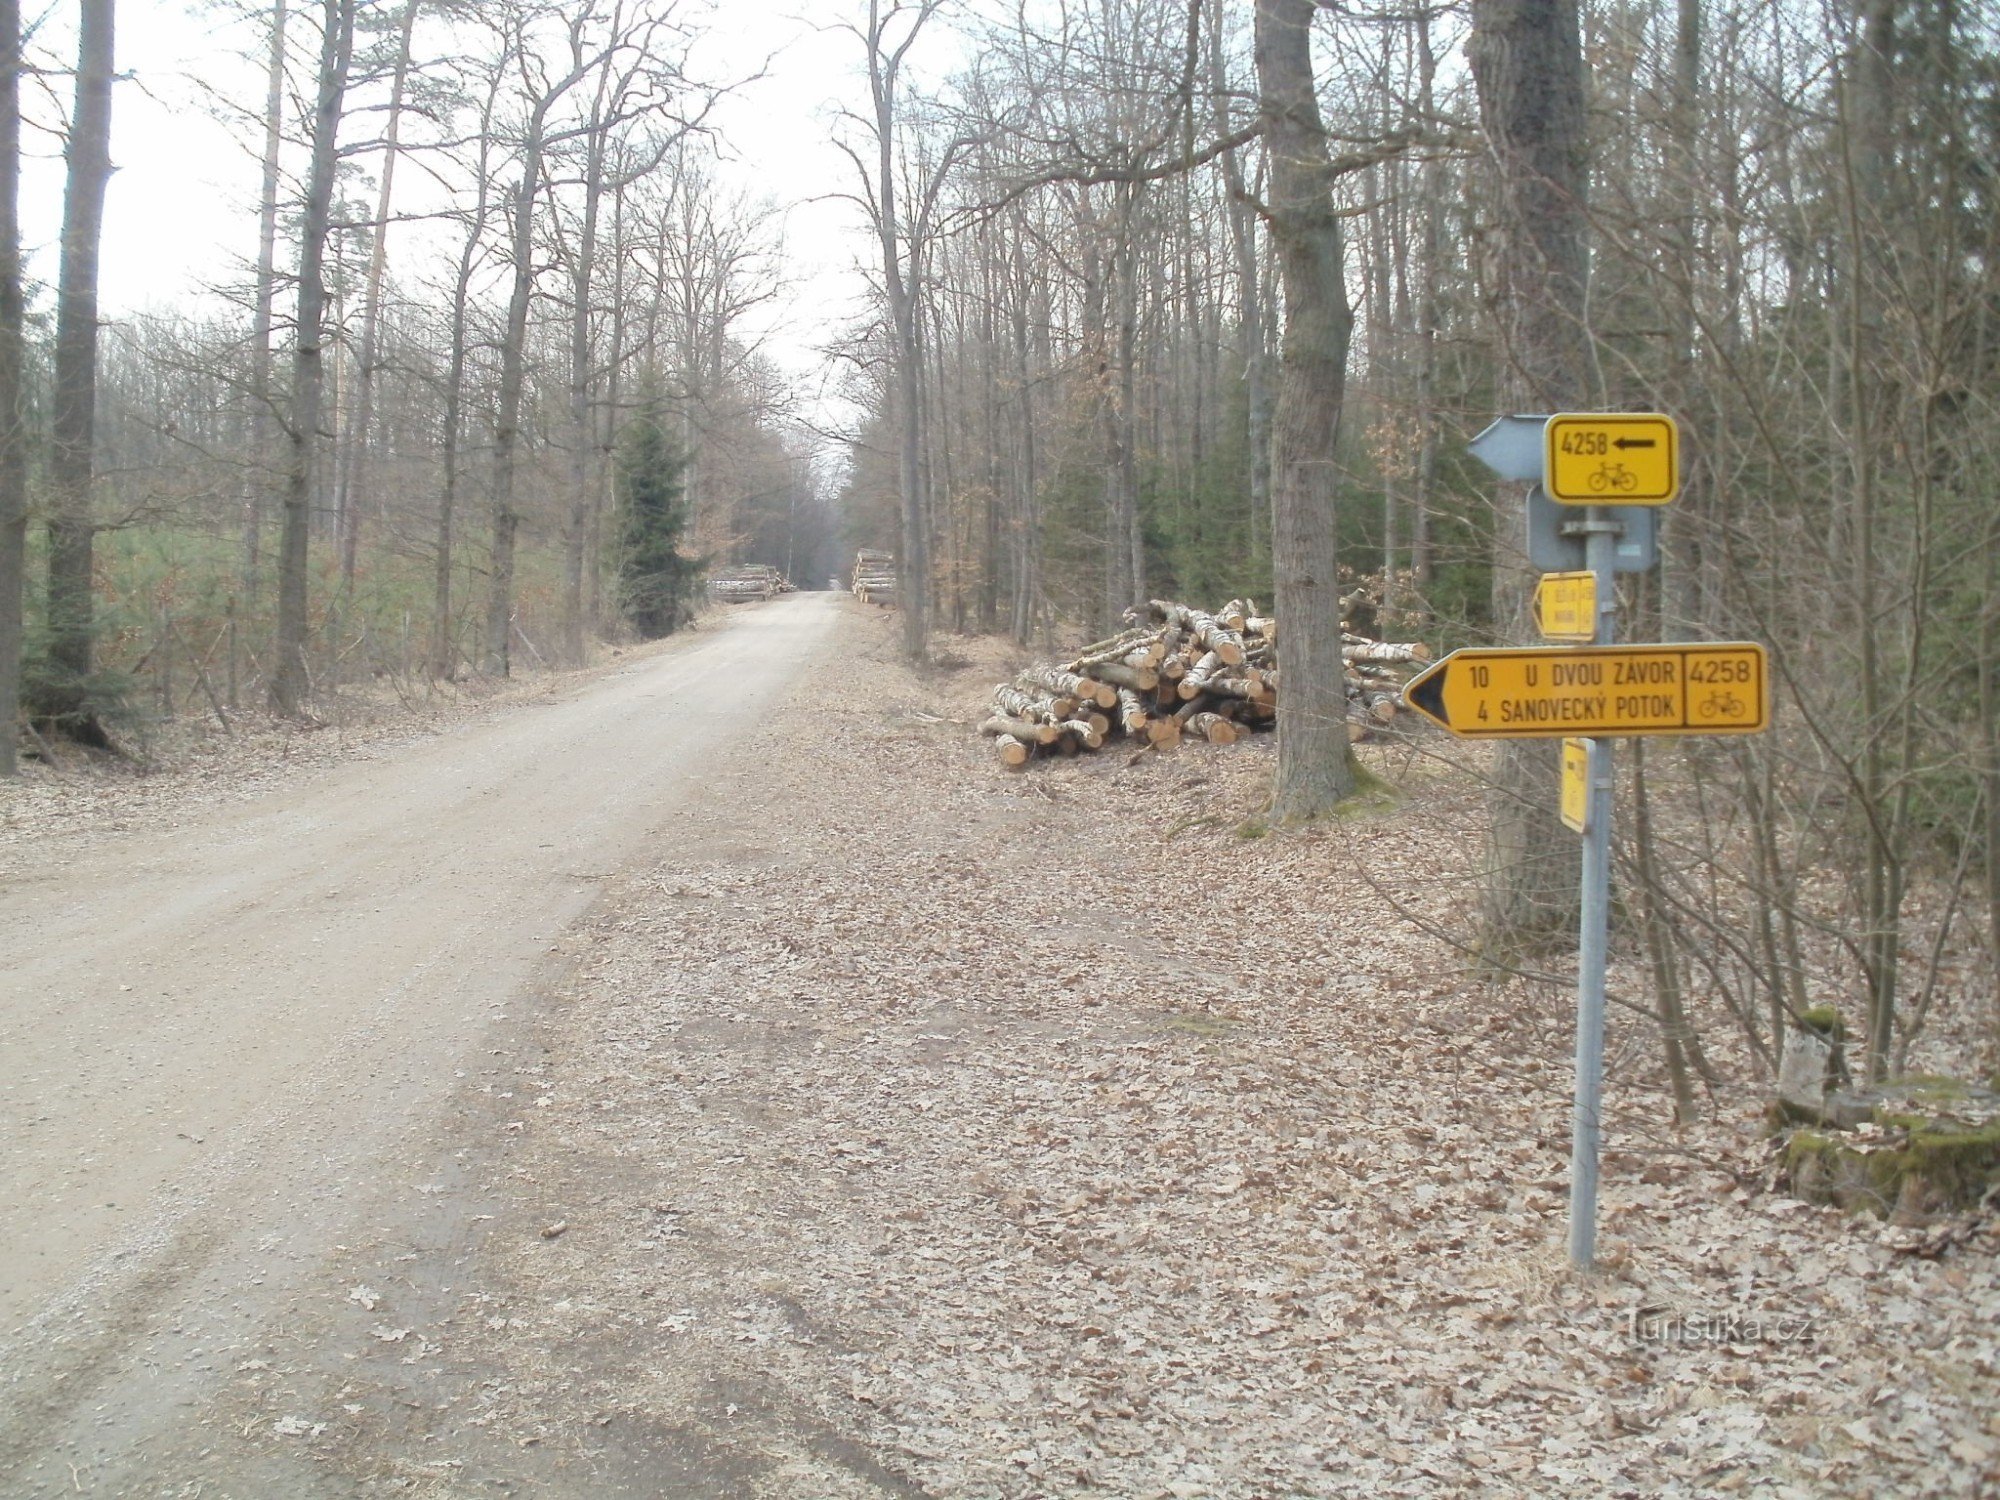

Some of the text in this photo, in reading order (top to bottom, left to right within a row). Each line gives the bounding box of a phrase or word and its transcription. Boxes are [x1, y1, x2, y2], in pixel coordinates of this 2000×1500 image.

[1561, 432, 1608, 455] 4258
[1469, 656, 1675, 688] 10 U DVOU ZÁVOR
[1690, 660, 1750, 684] 4258
[1477, 692, 1675, 722] 4 SANOVECKÝ POTOK
